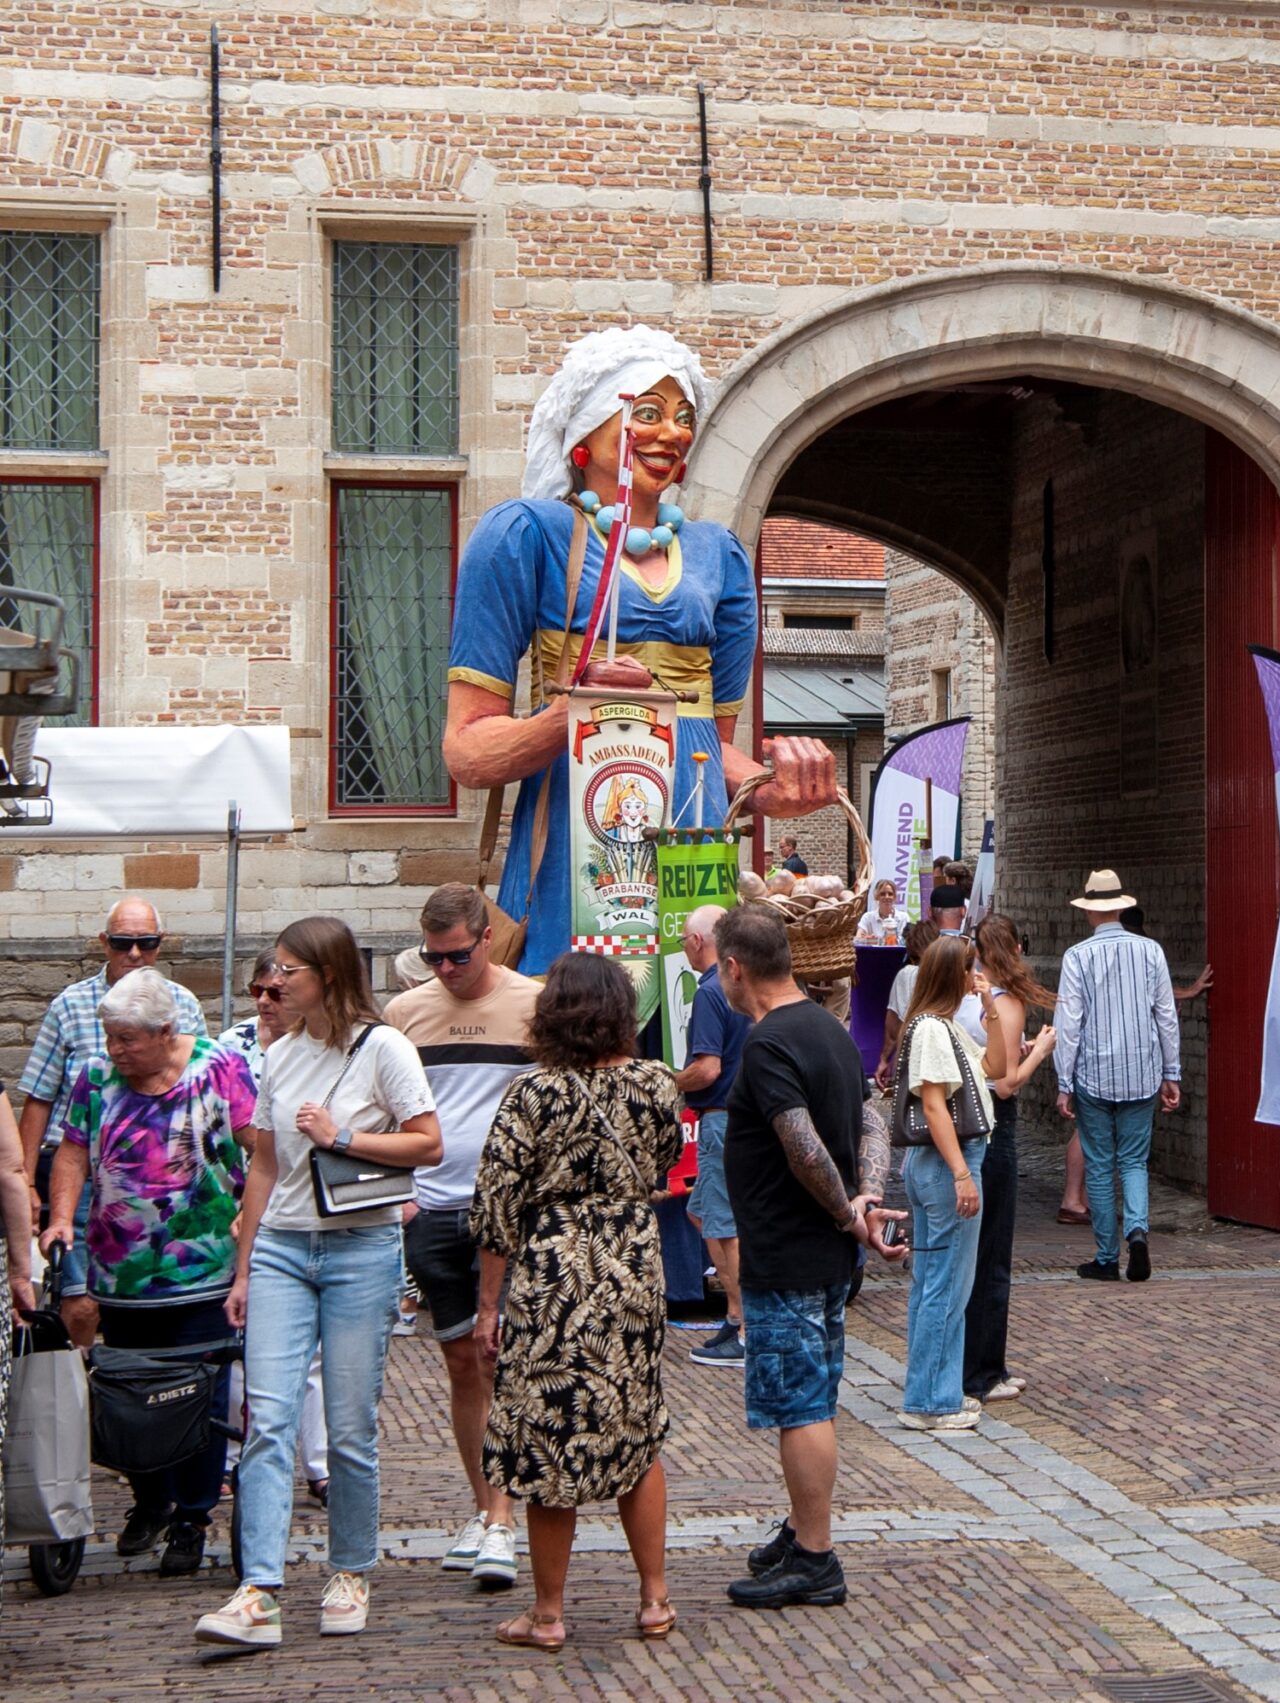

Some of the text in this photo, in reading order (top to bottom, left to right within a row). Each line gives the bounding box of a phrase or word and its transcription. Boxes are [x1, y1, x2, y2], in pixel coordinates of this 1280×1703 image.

[599, 706, 650, 720] ASPERGILDA
[589, 744, 666, 768] AMBASSADEUR
[894, 802, 913, 905] ENAVEND
[662, 863, 738, 898] REUZEN
[602, 884, 657, 898] BRABANTSE
[612, 911, 650, 921] WAL
[449, 1025, 486, 1036] BALLIN
[158, 1384, 197, 1401] DIETZ
